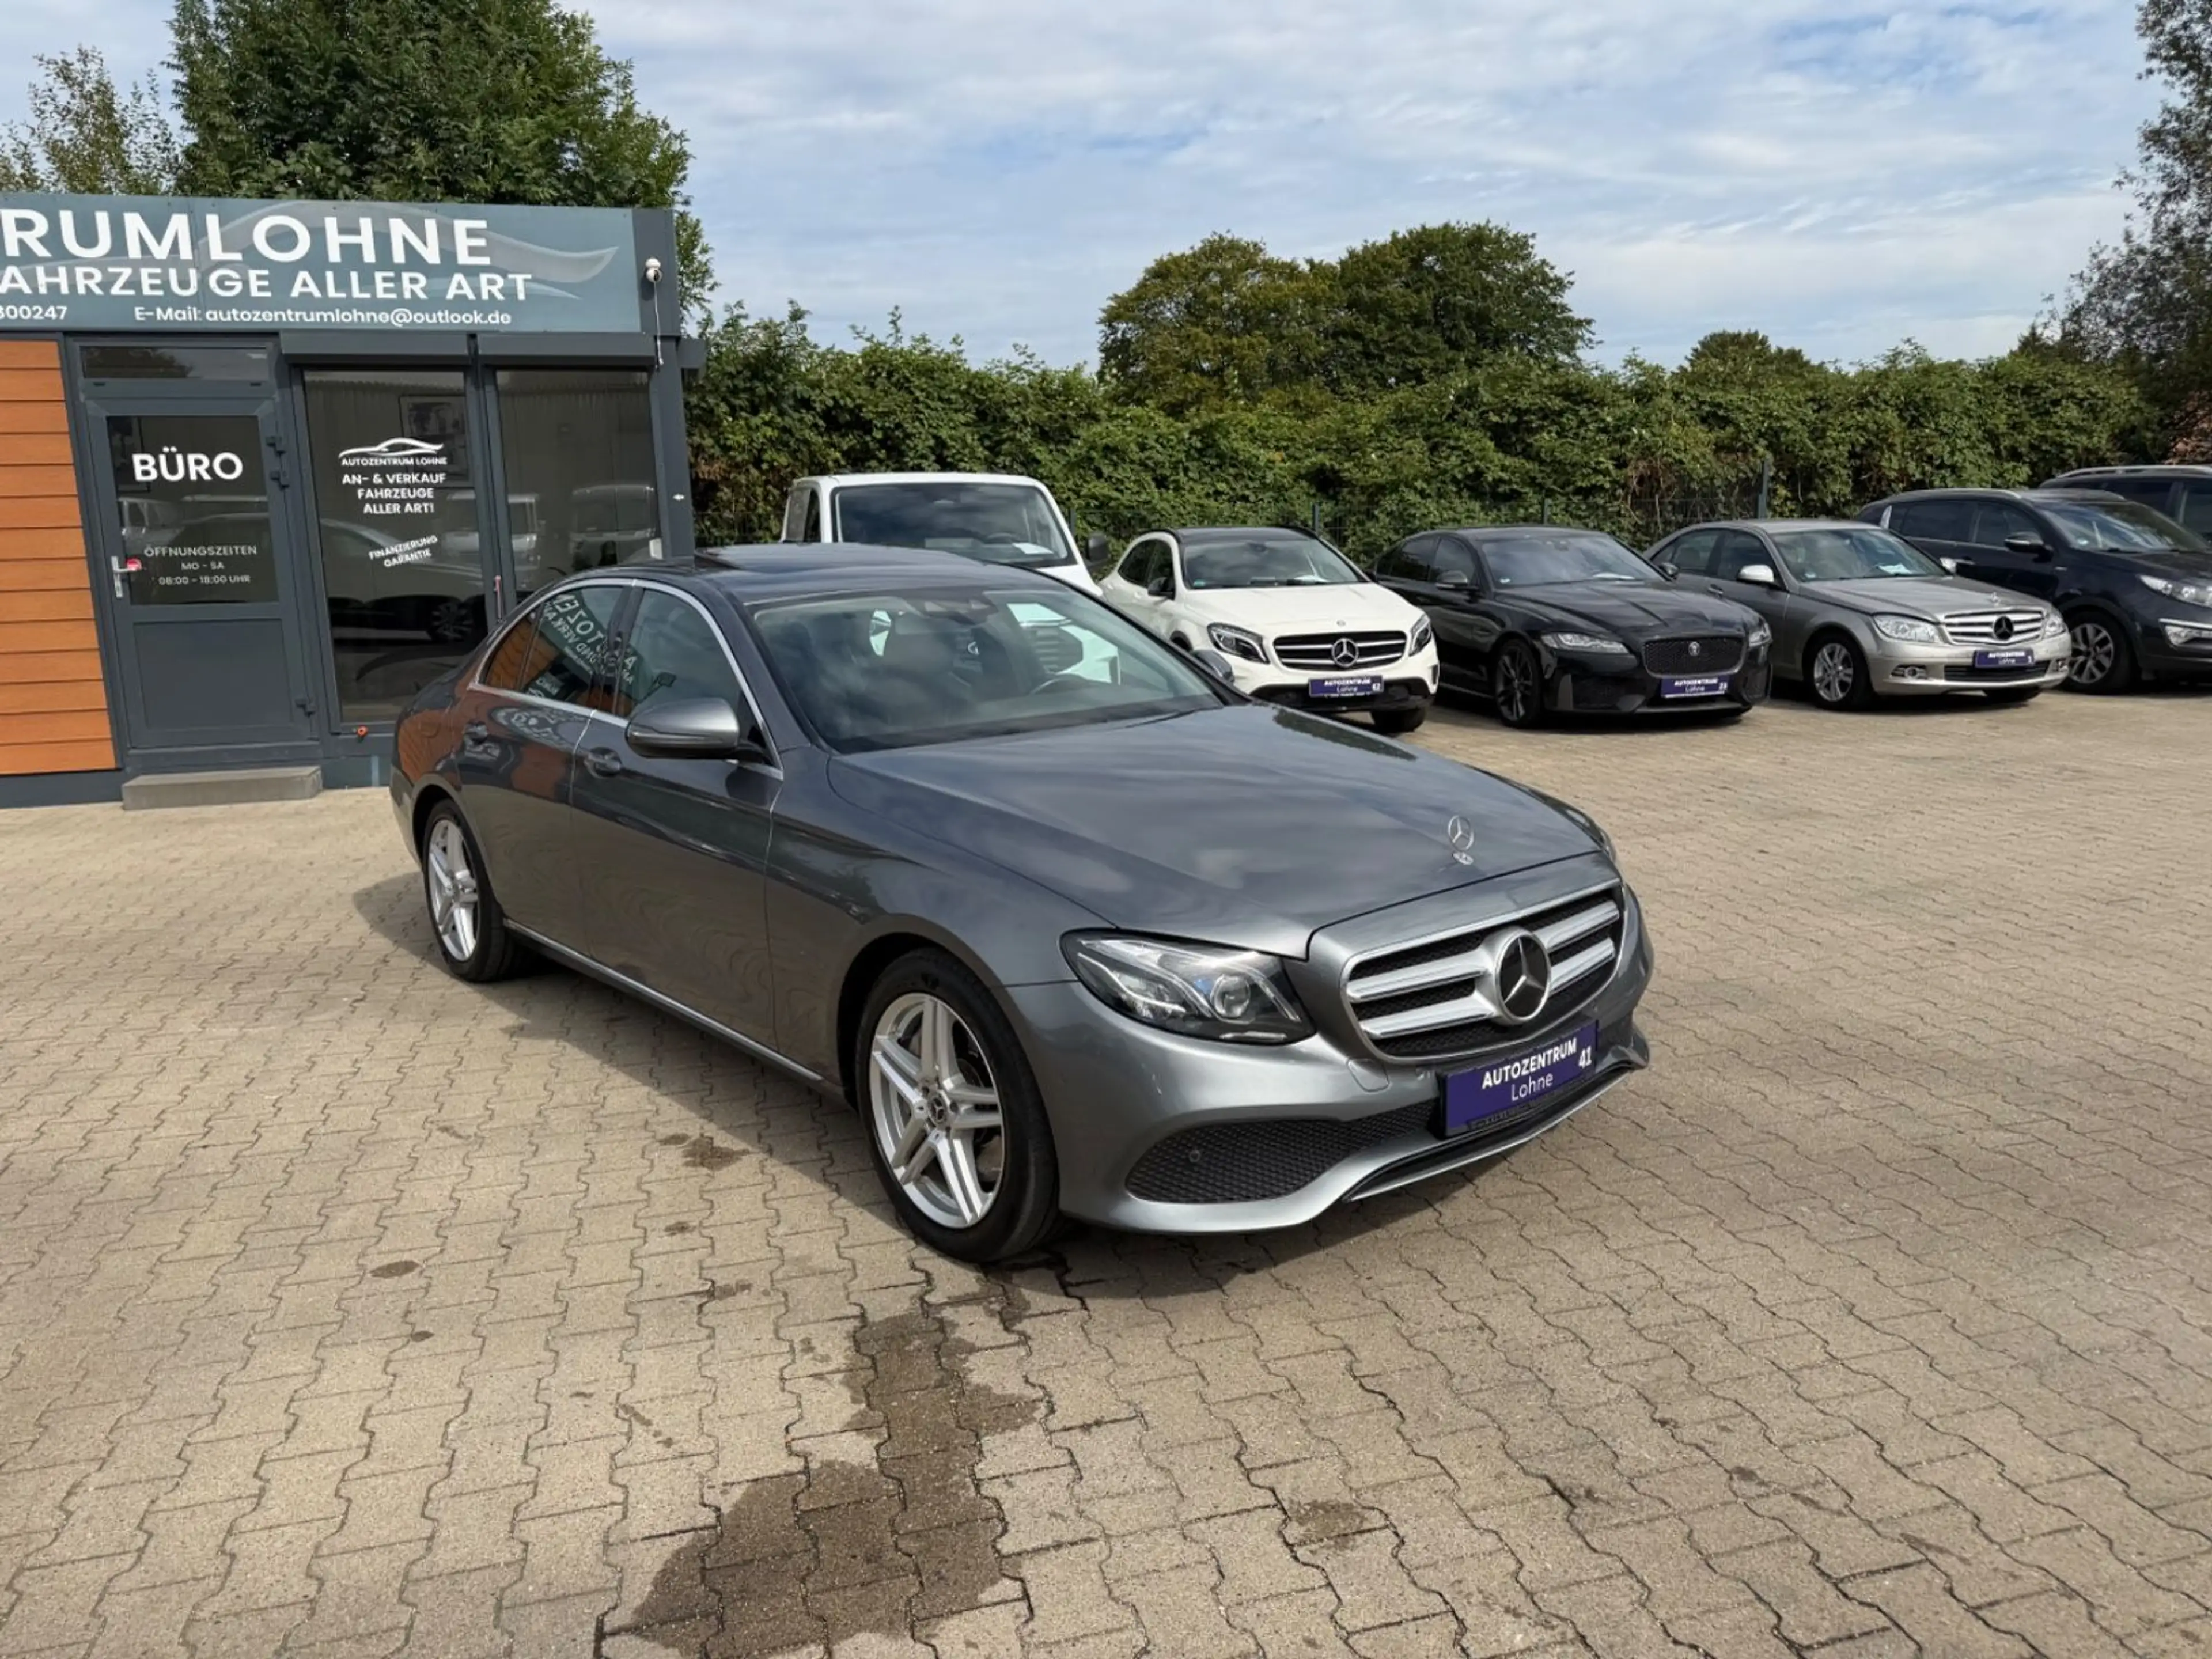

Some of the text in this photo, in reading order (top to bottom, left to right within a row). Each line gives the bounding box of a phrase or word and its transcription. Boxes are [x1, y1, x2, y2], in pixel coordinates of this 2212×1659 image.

[0, 208, 491, 266] RUMLOHNE
[0, 266, 532, 301] AHRZEUGE ALLER ART
[134, 306, 202, 322] E-Mail:
[205, 308, 512, 328] autozentrumlohne@outlook.de
[131, 446, 244, 482] BÜRO
[342, 457, 448, 466] AUTOZENTRUM LOHNE
[342, 472, 447, 485] AN- & VERKAUF
[357, 488, 434, 500] FAHRZEUGE
[363, 503, 401, 514] ALLER
[144, 544, 257, 558] ÖFFNUNGSZEITEN
[368, 535, 438, 560] FINANZIERUNG
[383, 548, 432, 567] GARANTIE
[181, 562, 200, 570] MO
[210, 560, 225, 570] SA
[229, 574, 251, 584] UHR
[1482, 1037, 1577, 1090] AUTOZENTRUM
[1578, 1046, 1592, 1069] 41
[1511, 1073, 1554, 1102] Lohne
